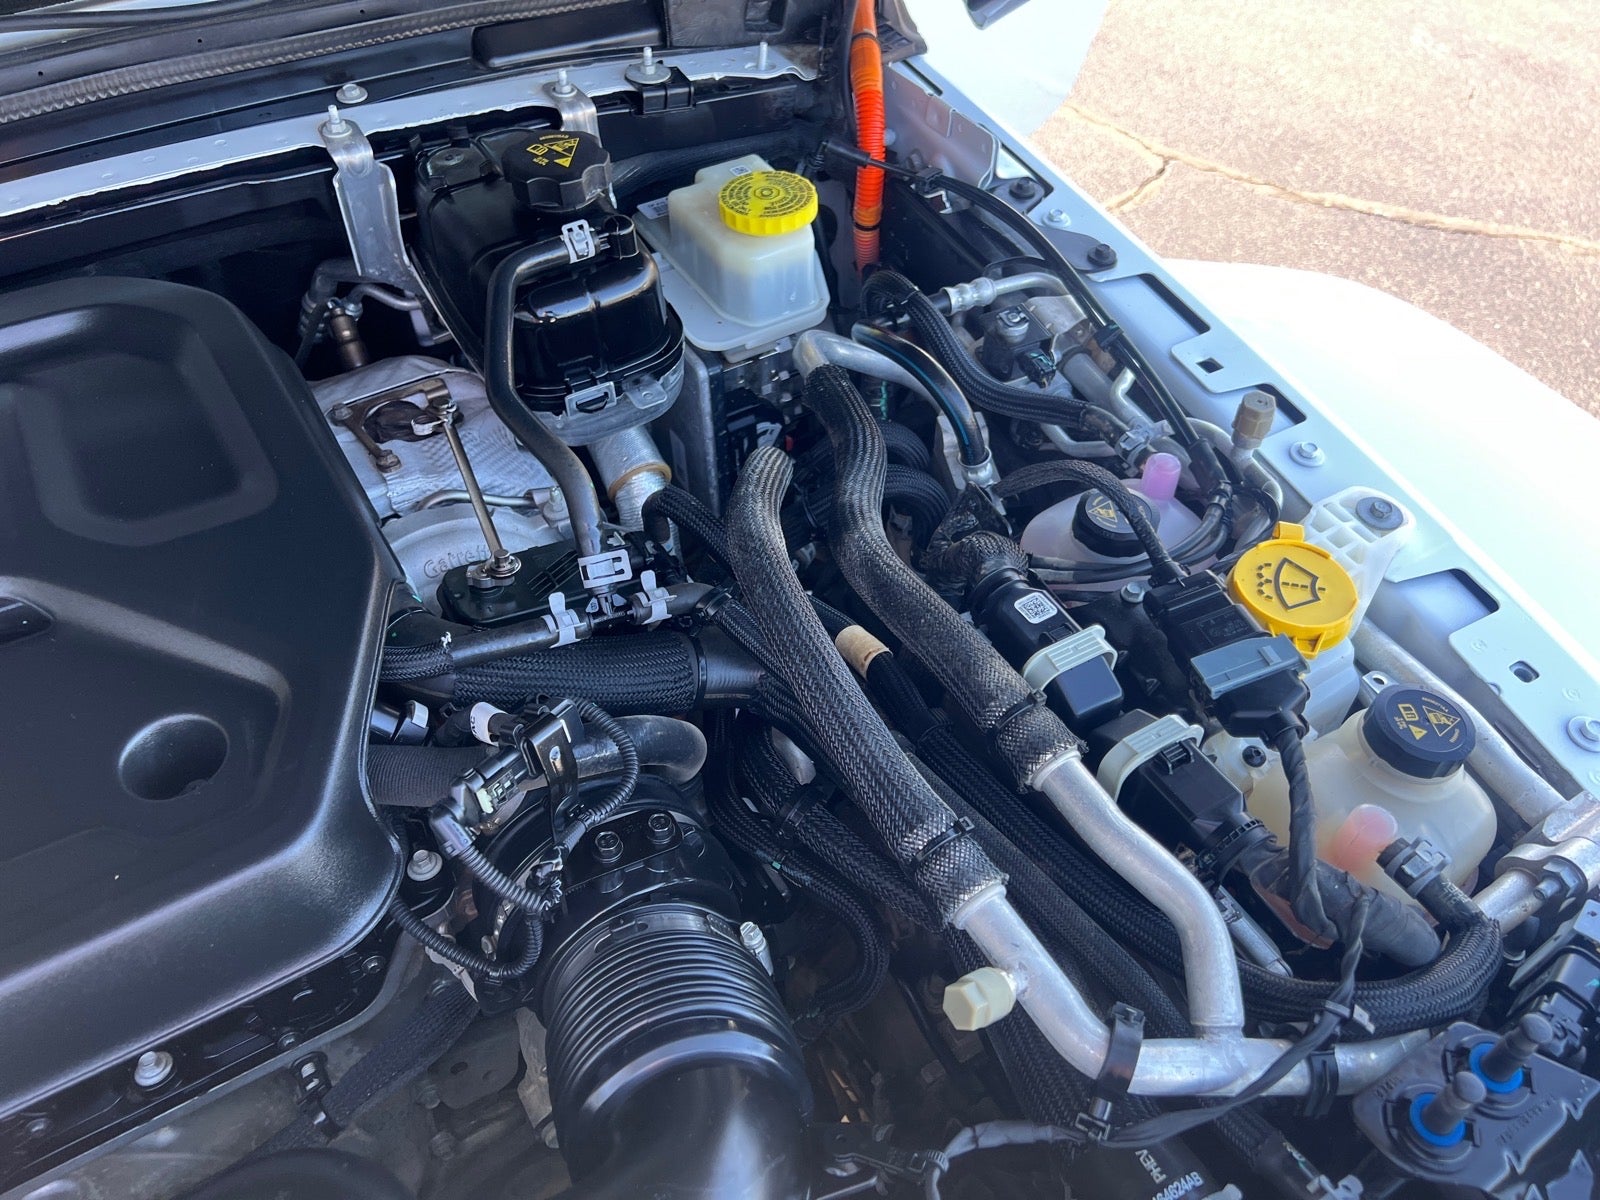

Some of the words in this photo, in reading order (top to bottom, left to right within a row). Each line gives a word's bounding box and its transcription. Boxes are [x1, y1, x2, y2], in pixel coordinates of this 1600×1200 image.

[423, 544, 488, 579] Garrett
[1135, 1149, 1167, 1184] PHEV
[1152, 1171, 1204, 1200] 64624AB
